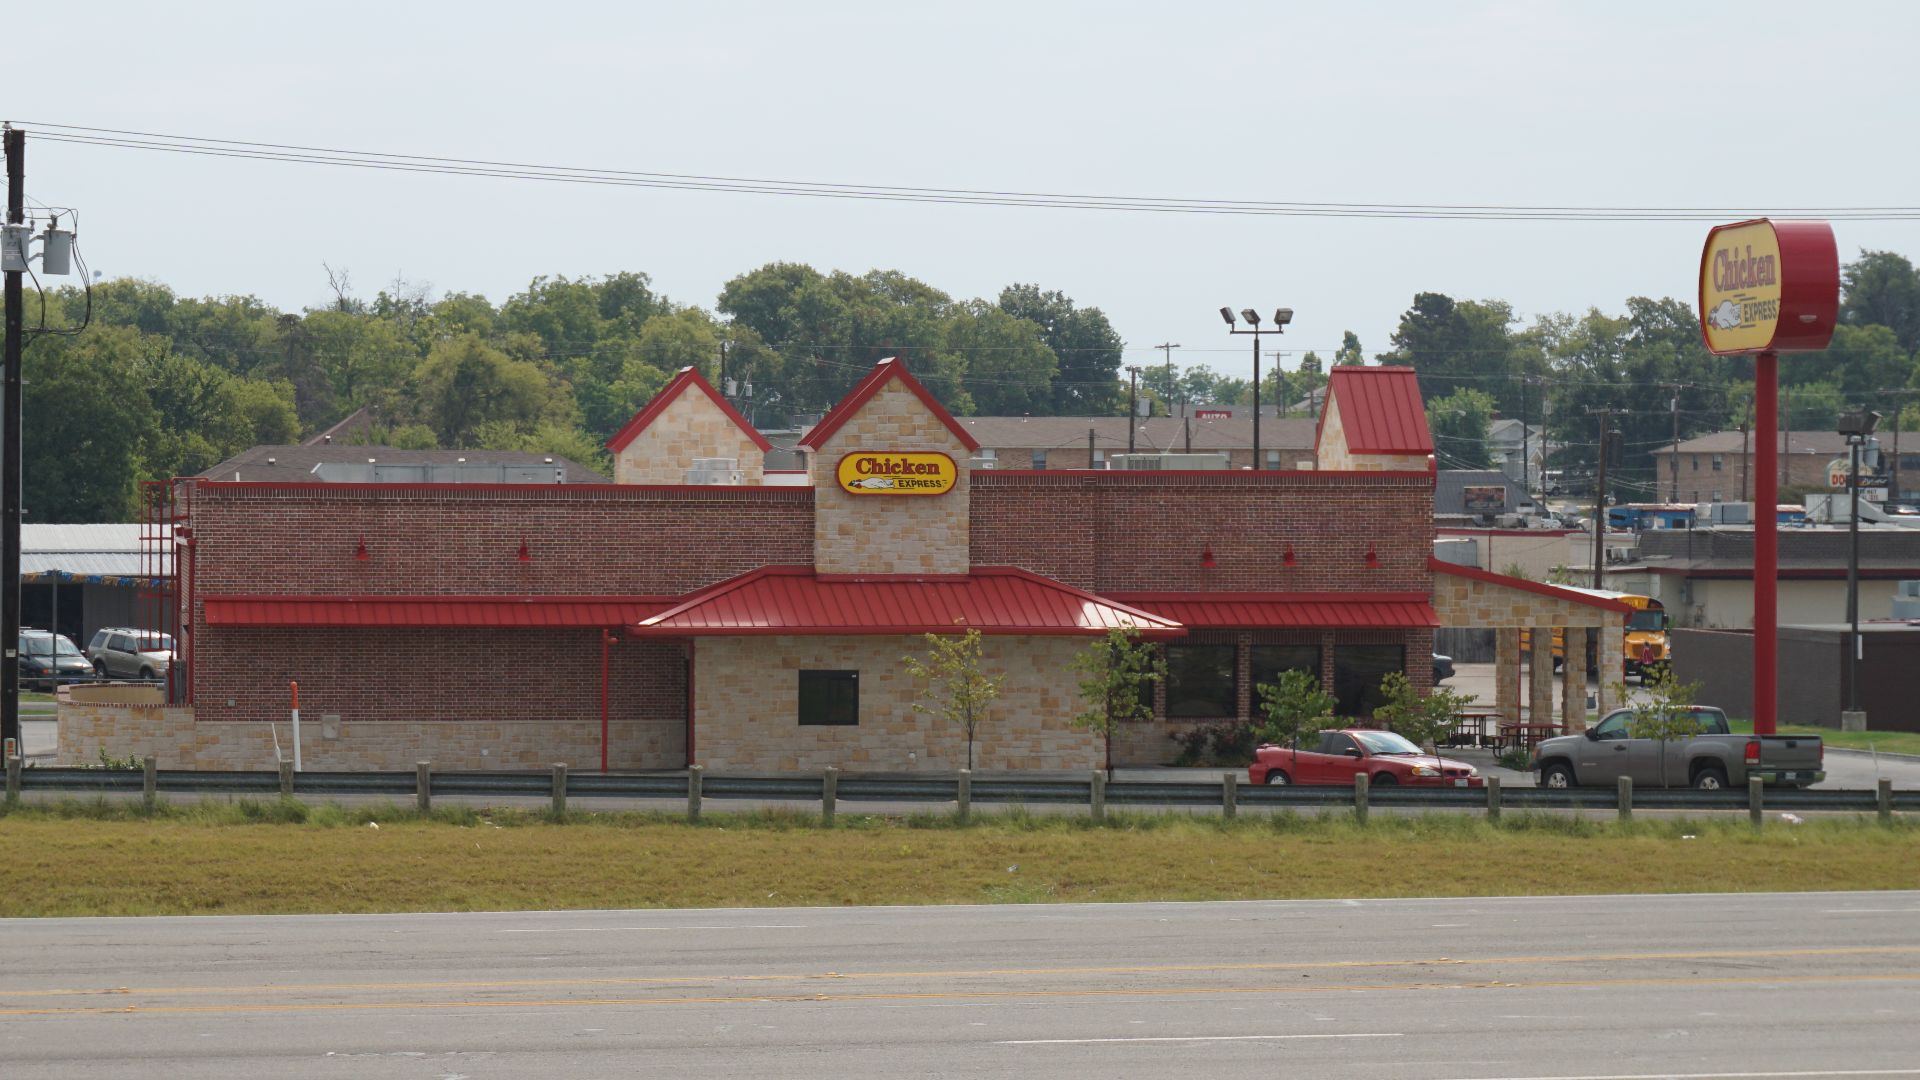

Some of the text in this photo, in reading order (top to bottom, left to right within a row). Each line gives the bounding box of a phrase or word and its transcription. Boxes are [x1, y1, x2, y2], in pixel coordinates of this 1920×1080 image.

[1713, 245, 1776, 293] Chicken
[1743, 301, 1777, 322] EXPRESS
[855, 458, 941, 475] Chicken
[898, 480, 942, 488] EXPRESS
